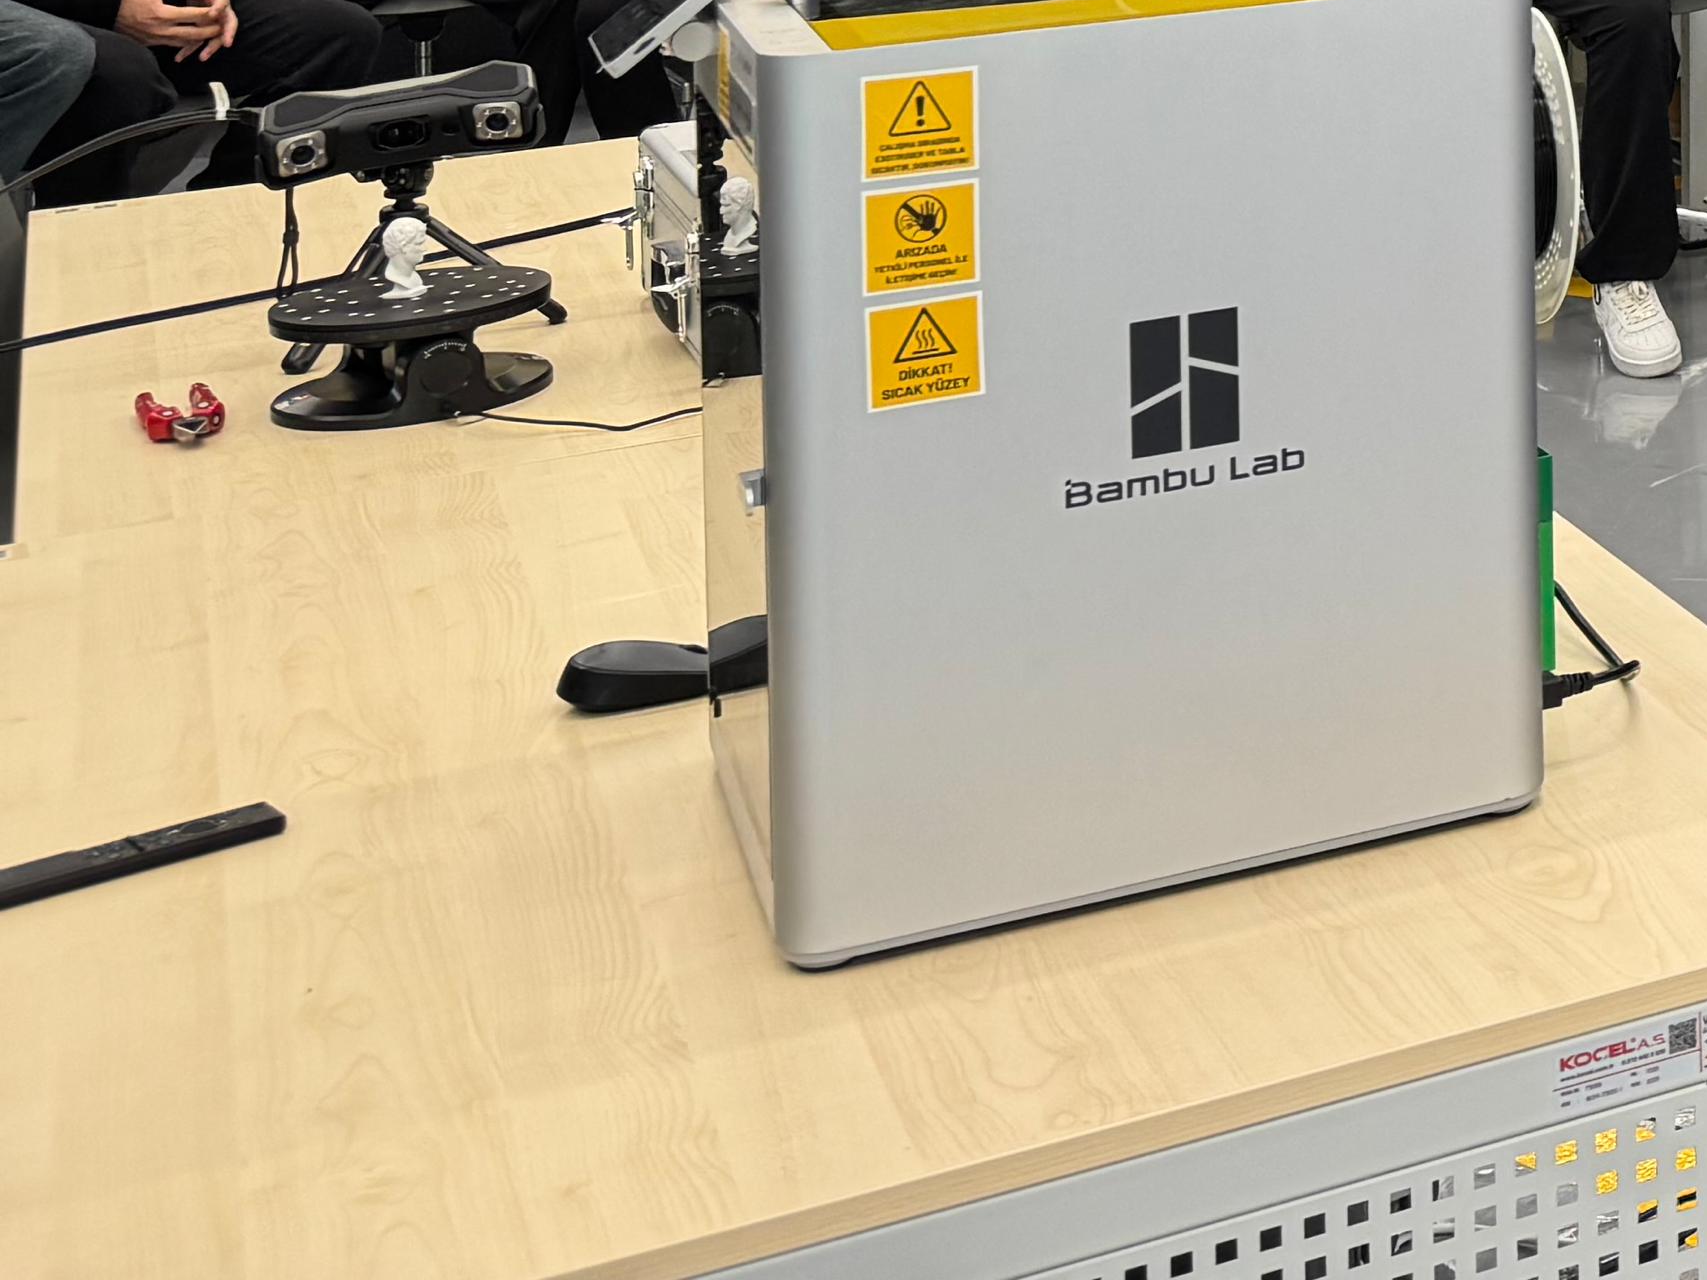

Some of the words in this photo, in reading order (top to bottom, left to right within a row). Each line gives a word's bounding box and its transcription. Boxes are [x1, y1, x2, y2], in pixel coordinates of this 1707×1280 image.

[881, 384, 923, 400] SICAK
[926, 376, 970, 393] YÜZEY
[1065, 464, 1215, 509] Bambu
[1229, 448, 1305, 481] Lab
